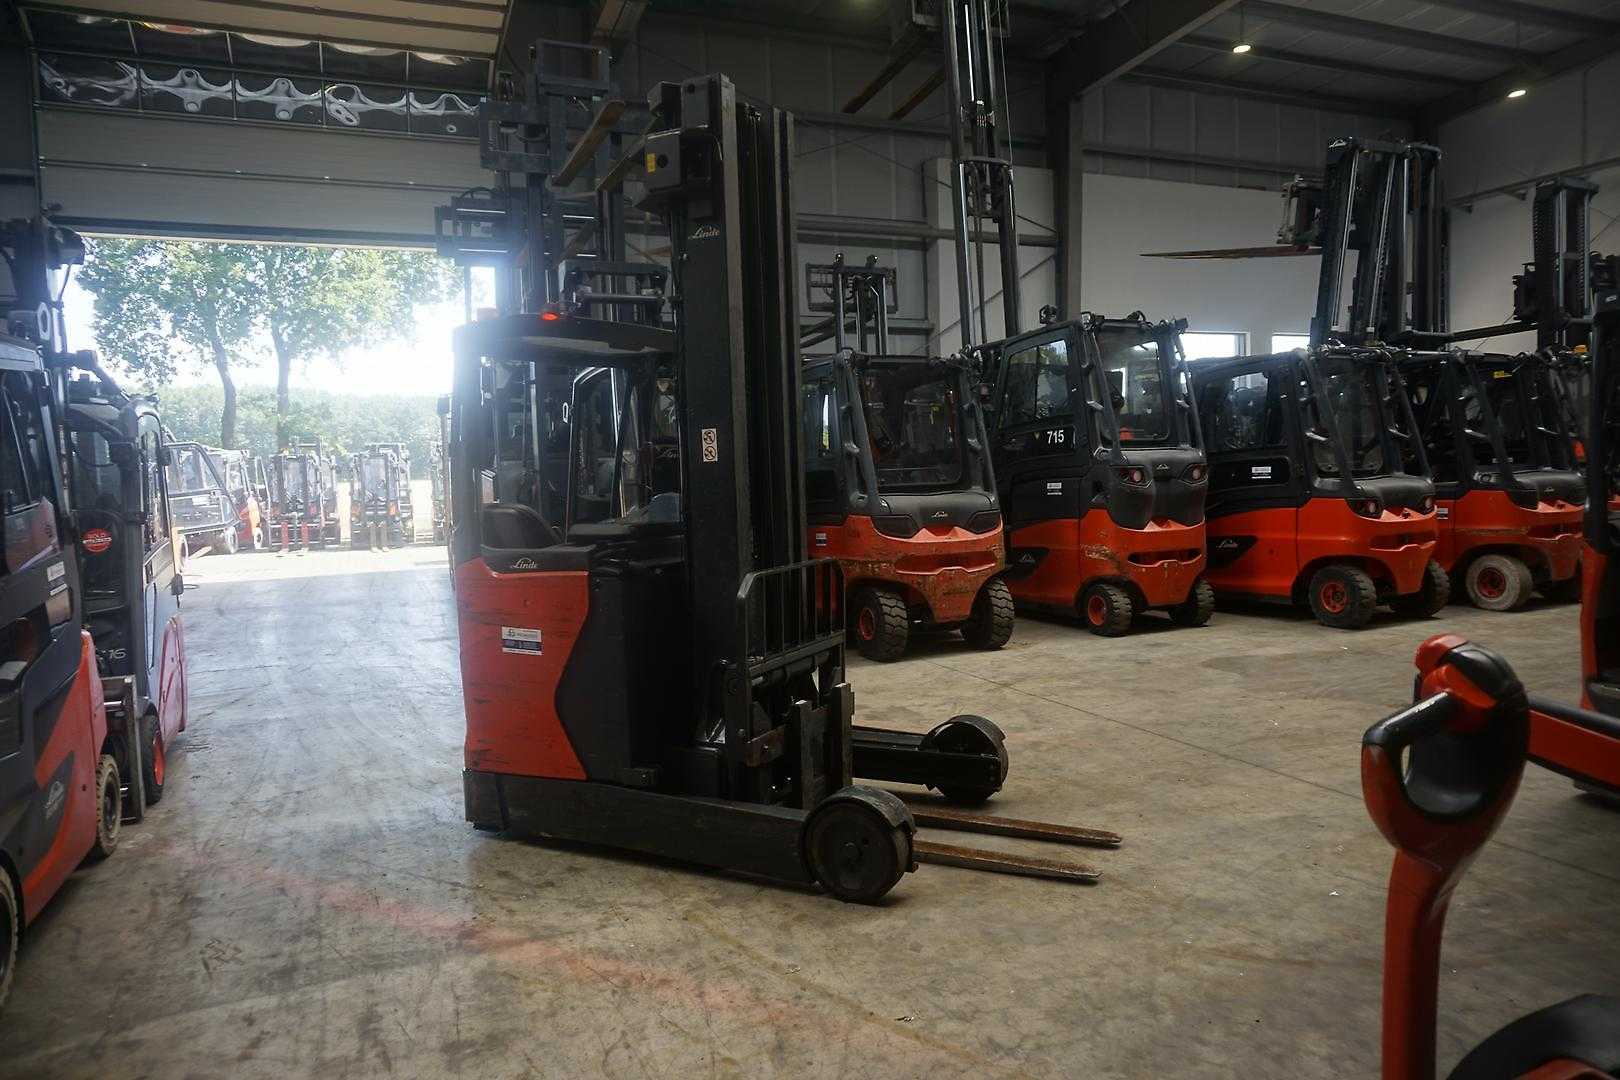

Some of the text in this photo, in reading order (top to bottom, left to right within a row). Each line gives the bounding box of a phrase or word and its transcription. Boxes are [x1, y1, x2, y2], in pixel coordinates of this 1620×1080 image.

[688, 226, 721, 239] Linde
[1047, 429, 1065, 444] 715
[510, 557, 538, 569] Linde
